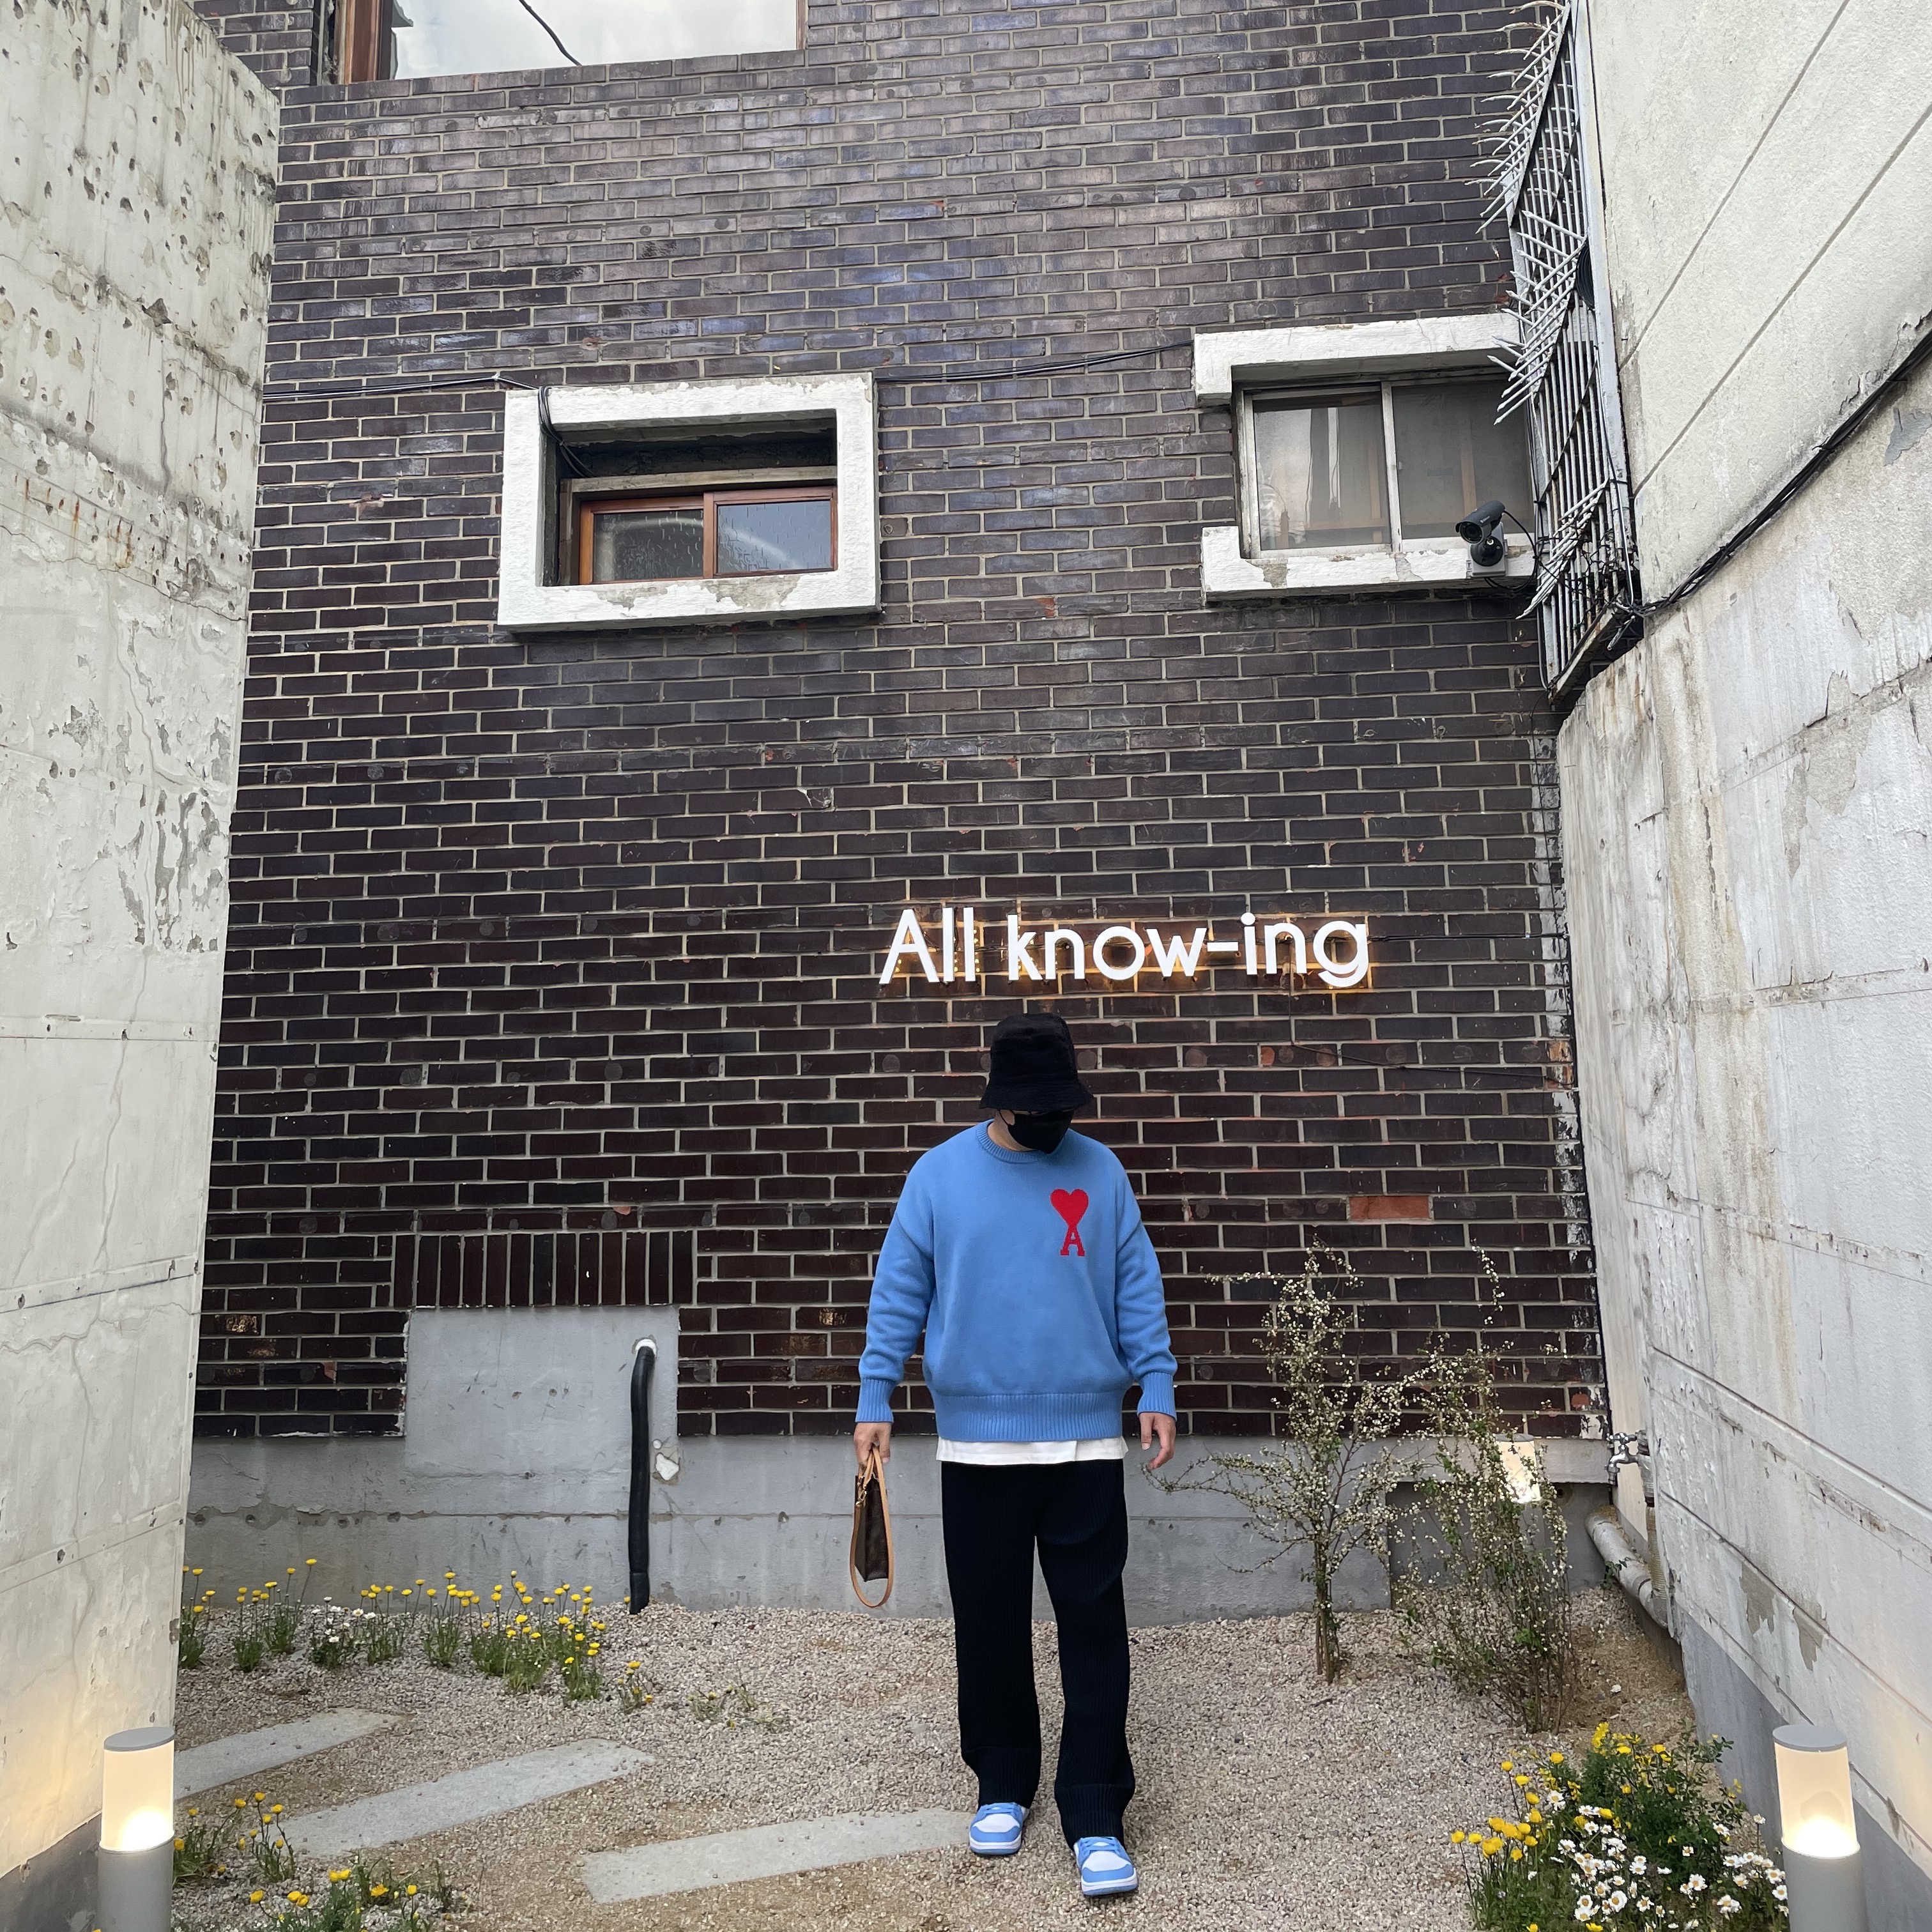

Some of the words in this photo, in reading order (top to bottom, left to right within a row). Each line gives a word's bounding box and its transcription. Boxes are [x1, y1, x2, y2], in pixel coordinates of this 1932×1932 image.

[878, 907, 976, 985] All
[1007, 912, 1370, 988] know-ing
[1060, 1225, 1085, 1257] A
